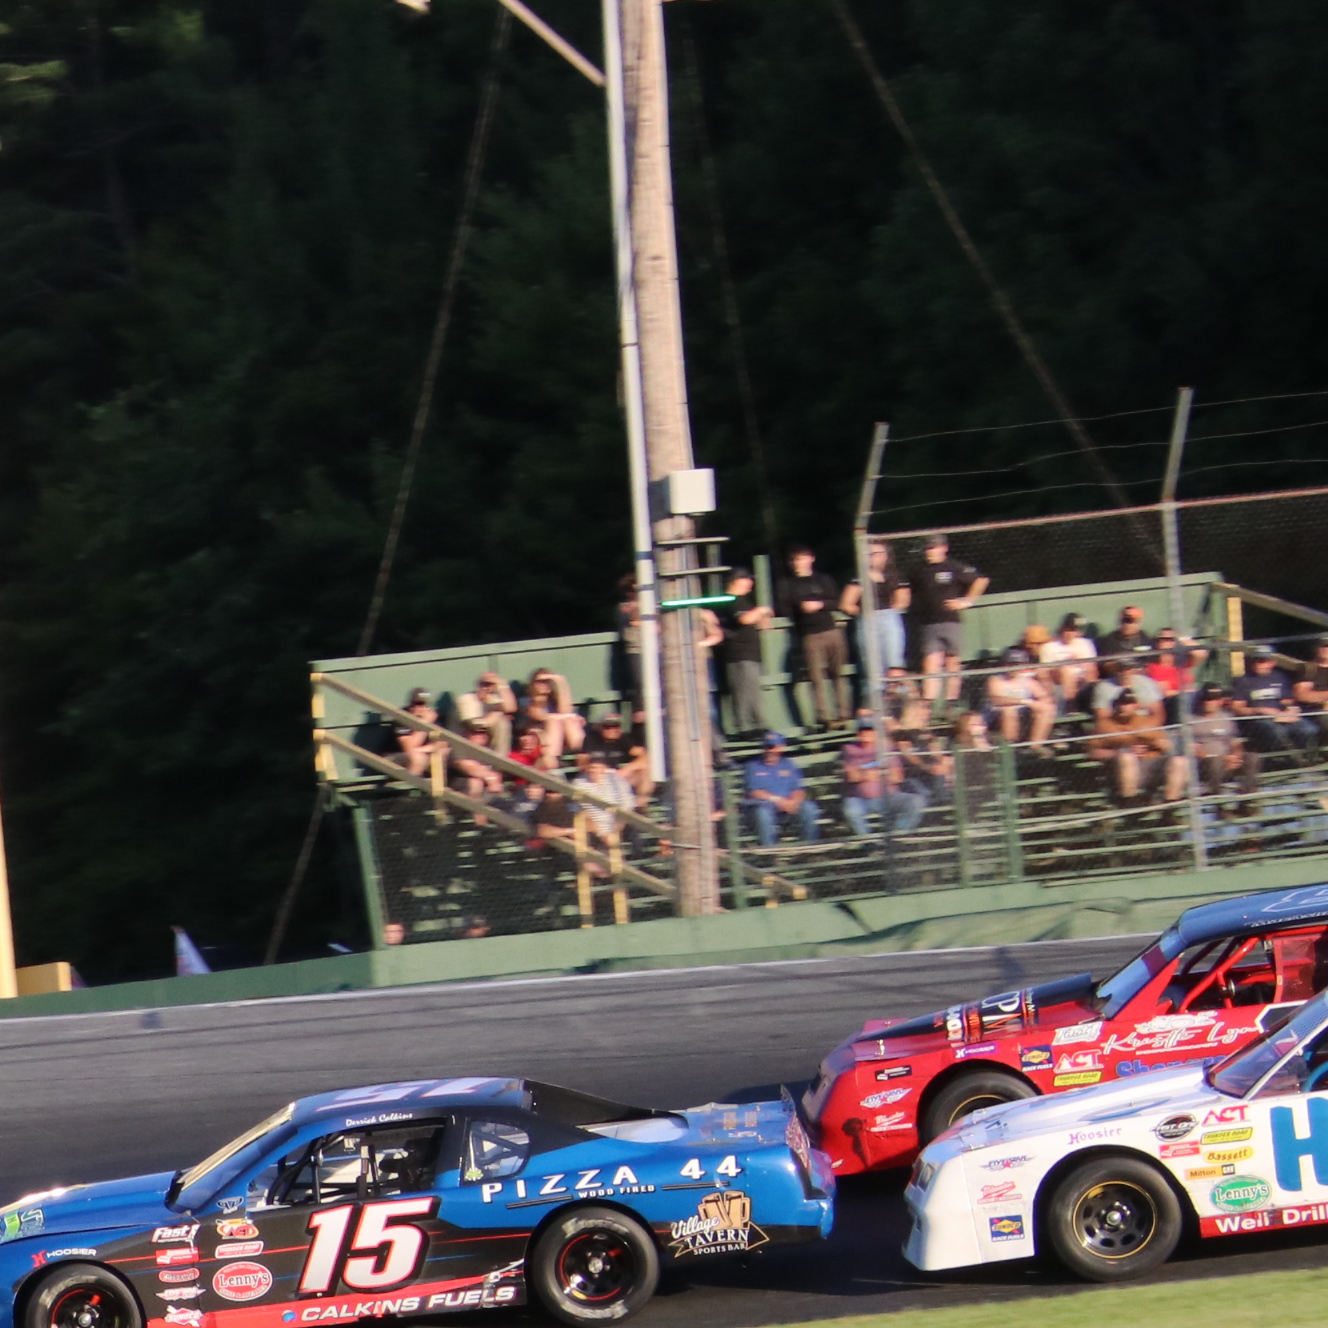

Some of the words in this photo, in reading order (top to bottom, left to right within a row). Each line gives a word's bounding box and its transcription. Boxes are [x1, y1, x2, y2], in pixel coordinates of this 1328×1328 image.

[1055, 1049, 1102, 1072] ACT
[345, 1116, 378, 1128] Derrick
[378, 1112, 413, 1124] Calkins
[1202, 1104, 1249, 1126] ACT
[1067, 1127, 1122, 1145] Hoosier
[1204, 1130, 1232, 1138] THUNDER
[1207, 1149, 1248, 1161] Bassett
[1189, 1169, 1216, 1178] Milton
[481, 1166, 639, 1204] PIZZA
[578, 1187, 614, 1199] WOOD
[619, 1184, 655, 1195] FIRED
[1215, 1184, 1269, 1201] Lenny's
[670, 1215, 720, 1238] Village
[993, 1222, 1021, 1231] SUNOCO
[1215, 1211, 1270, 1233] Well
[298, 1196, 434, 1294] 15
[684, 1228, 750, 1250] TAVERN
[46, 1248, 97, 1258] HOOSIER
[693, 1245, 726, 1256] SPORTS
[727, 1243, 747, 1253] BAR
[219, 1271, 270, 1288] Lenny's
[300, 1296, 420, 1322] CALKINS
[428, 1286, 516, 1309] FUELS
